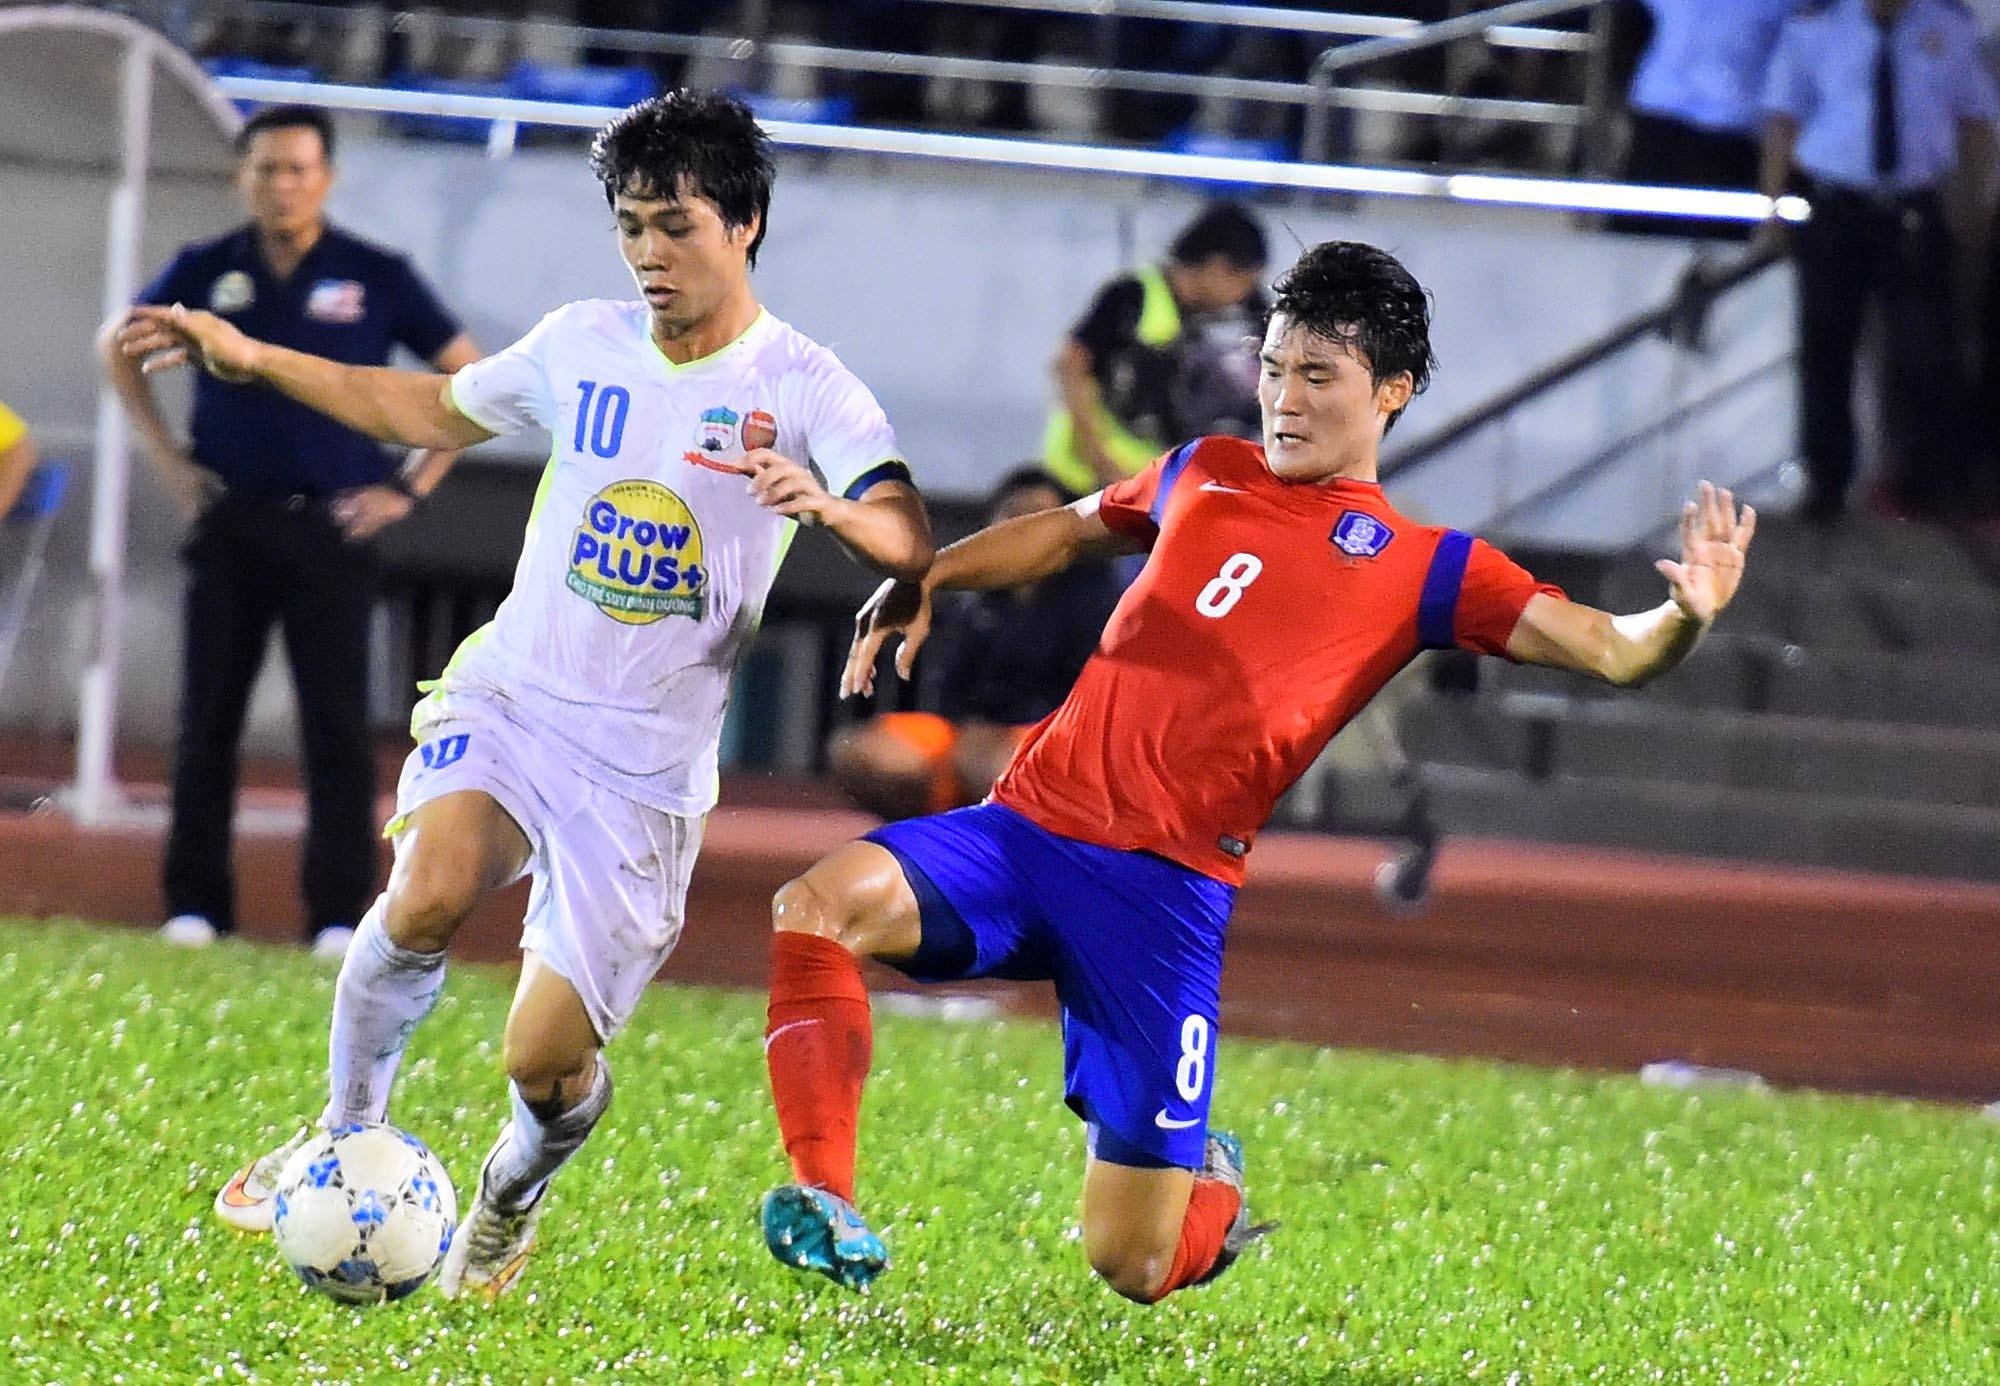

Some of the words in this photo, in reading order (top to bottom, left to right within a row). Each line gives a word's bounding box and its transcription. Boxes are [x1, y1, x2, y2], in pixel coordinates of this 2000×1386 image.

[574, 380, 630, 459] 10
[590, 500, 691, 551] Grow
[573, 532, 703, 591] PLUS+
[1195, 552, 1263, 618] 8
[1175, 1013, 1209, 1102] 8
